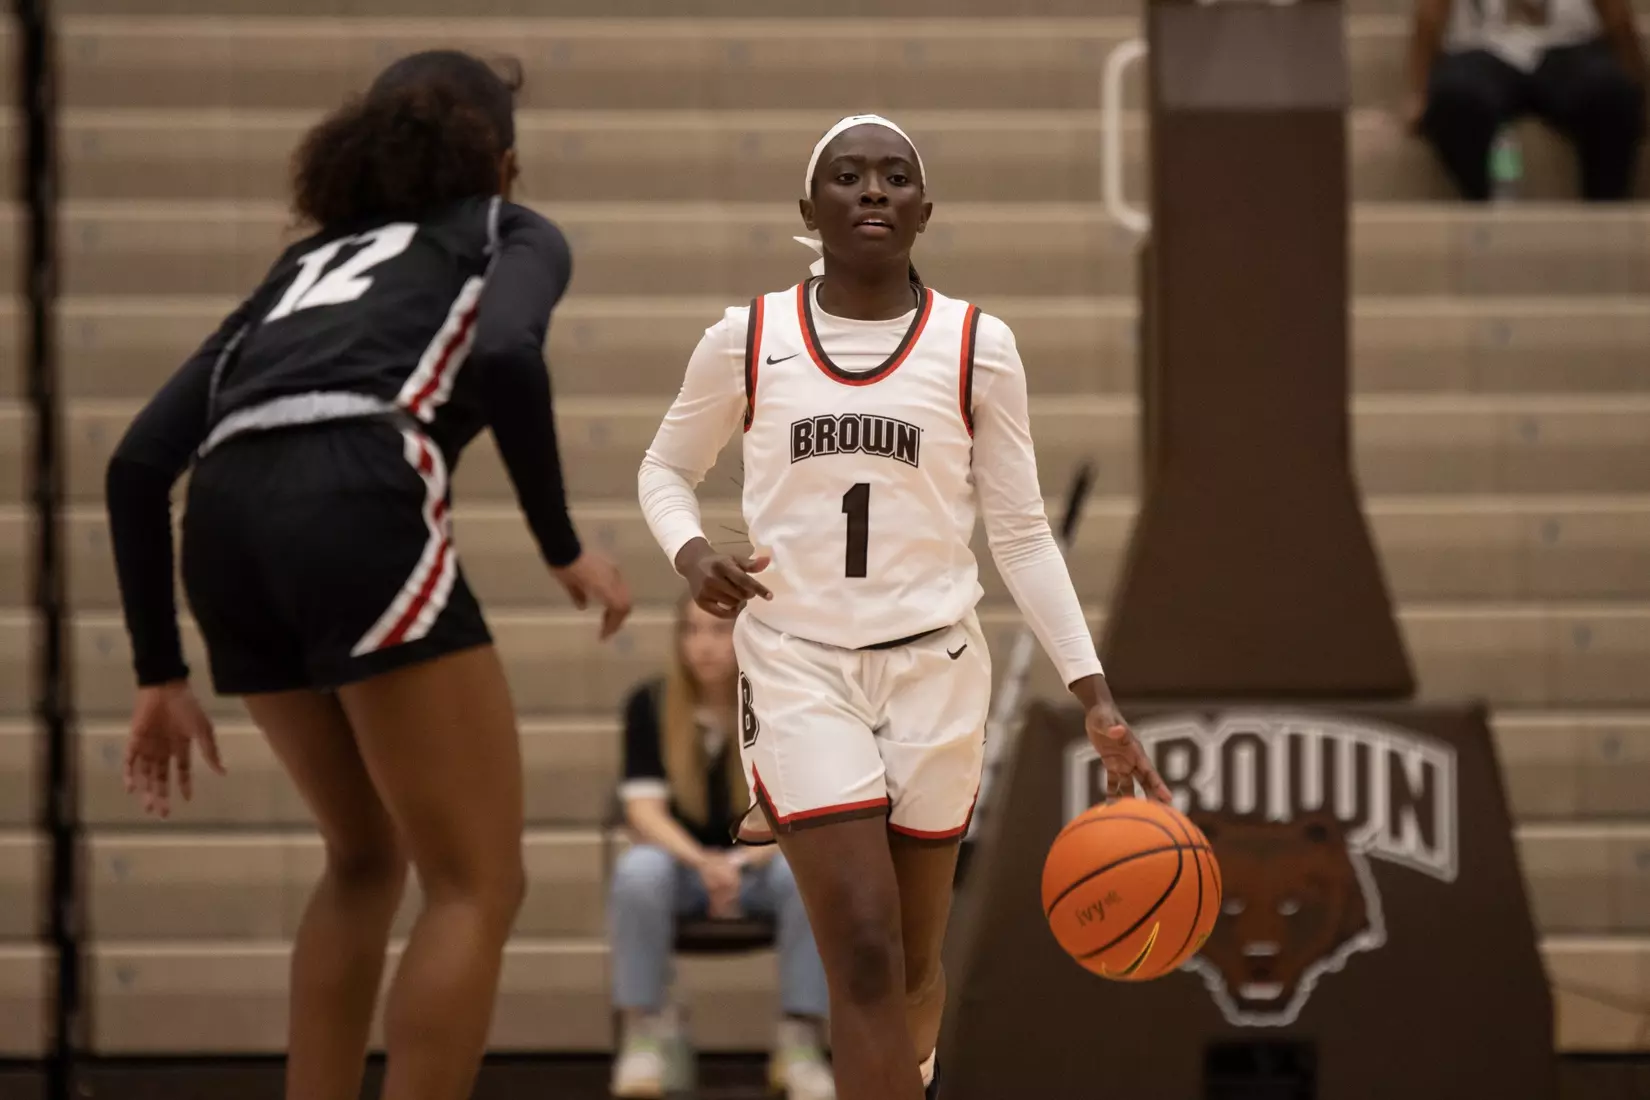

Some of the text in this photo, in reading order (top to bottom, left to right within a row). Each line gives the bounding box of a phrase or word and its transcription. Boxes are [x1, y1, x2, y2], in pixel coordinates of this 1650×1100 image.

[263, 221, 420, 324] 12
[790, 413, 920, 469] BROWN
[841, 482, 871, 578] 1
[739, 670, 760, 750] B
